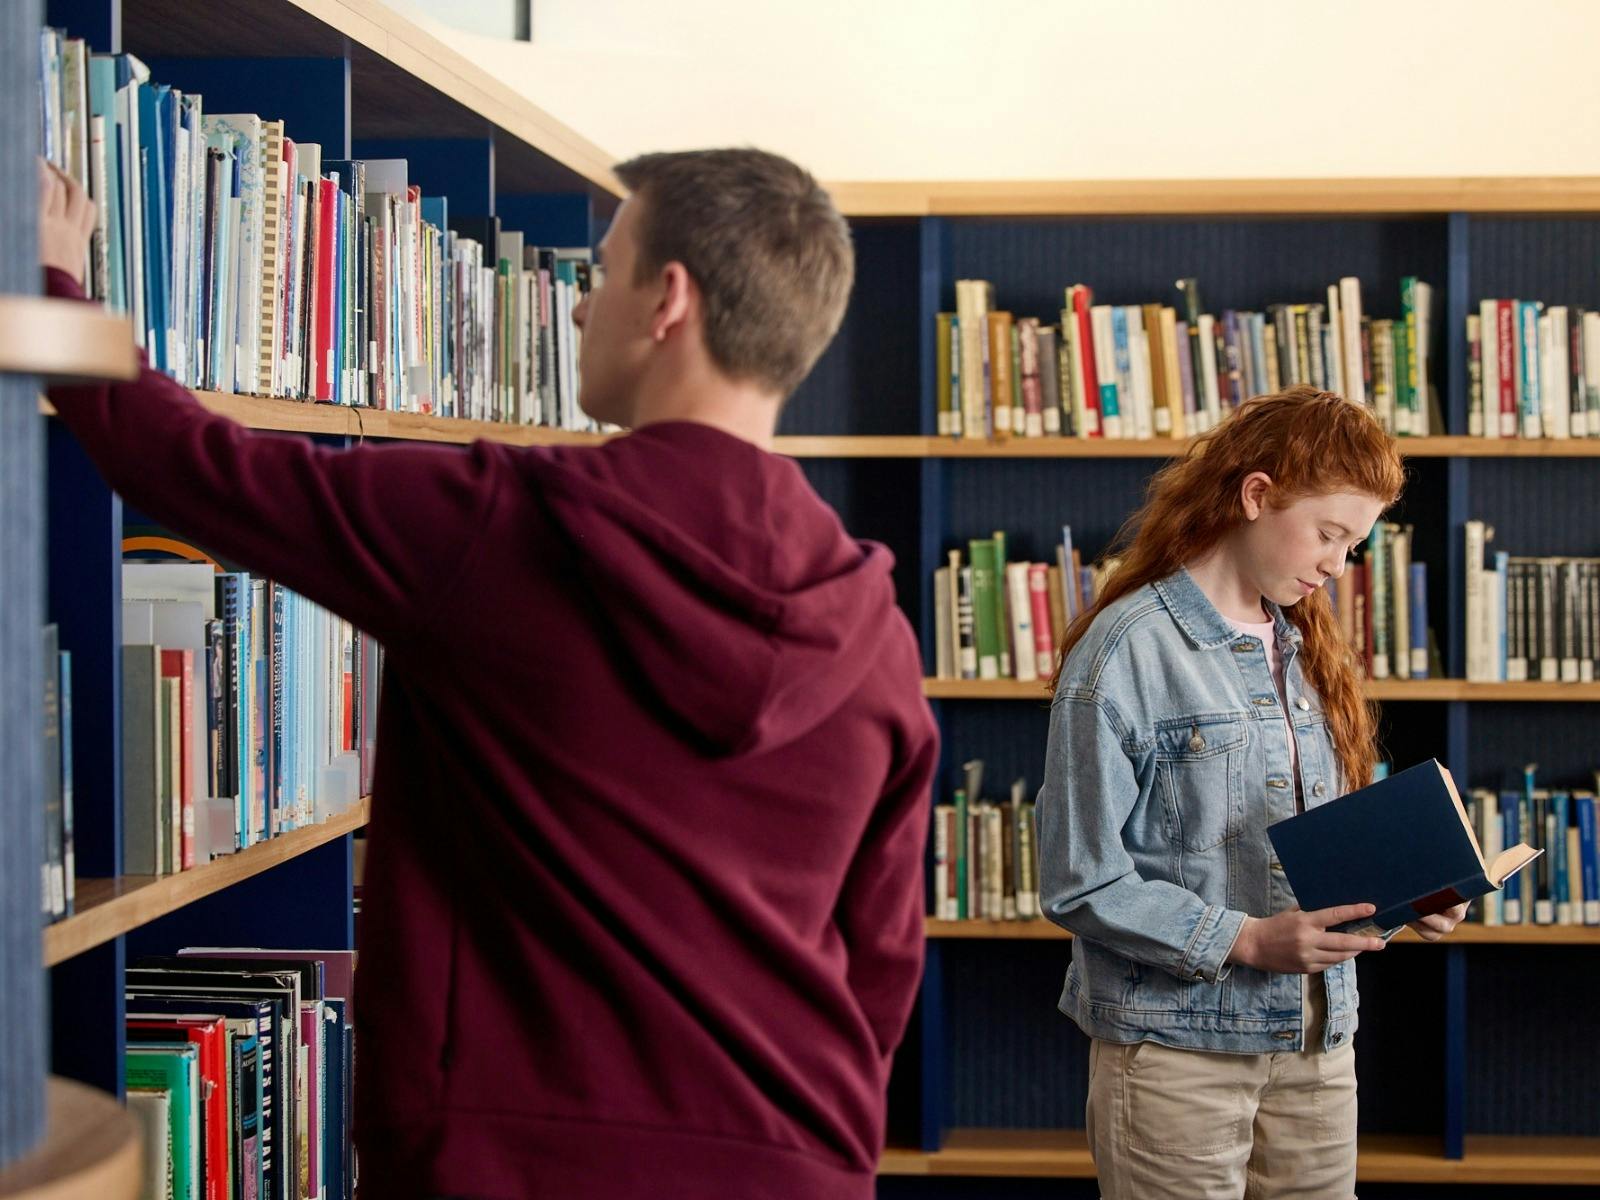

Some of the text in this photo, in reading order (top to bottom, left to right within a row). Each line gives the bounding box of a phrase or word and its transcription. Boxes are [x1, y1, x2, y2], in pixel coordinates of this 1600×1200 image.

[274, 651, 283, 697] WORLD
[259, 1005, 272, 1088] IMAGES
[262, 1096, 272, 1120] OF
[262, 1128, 272, 1172] WAR
